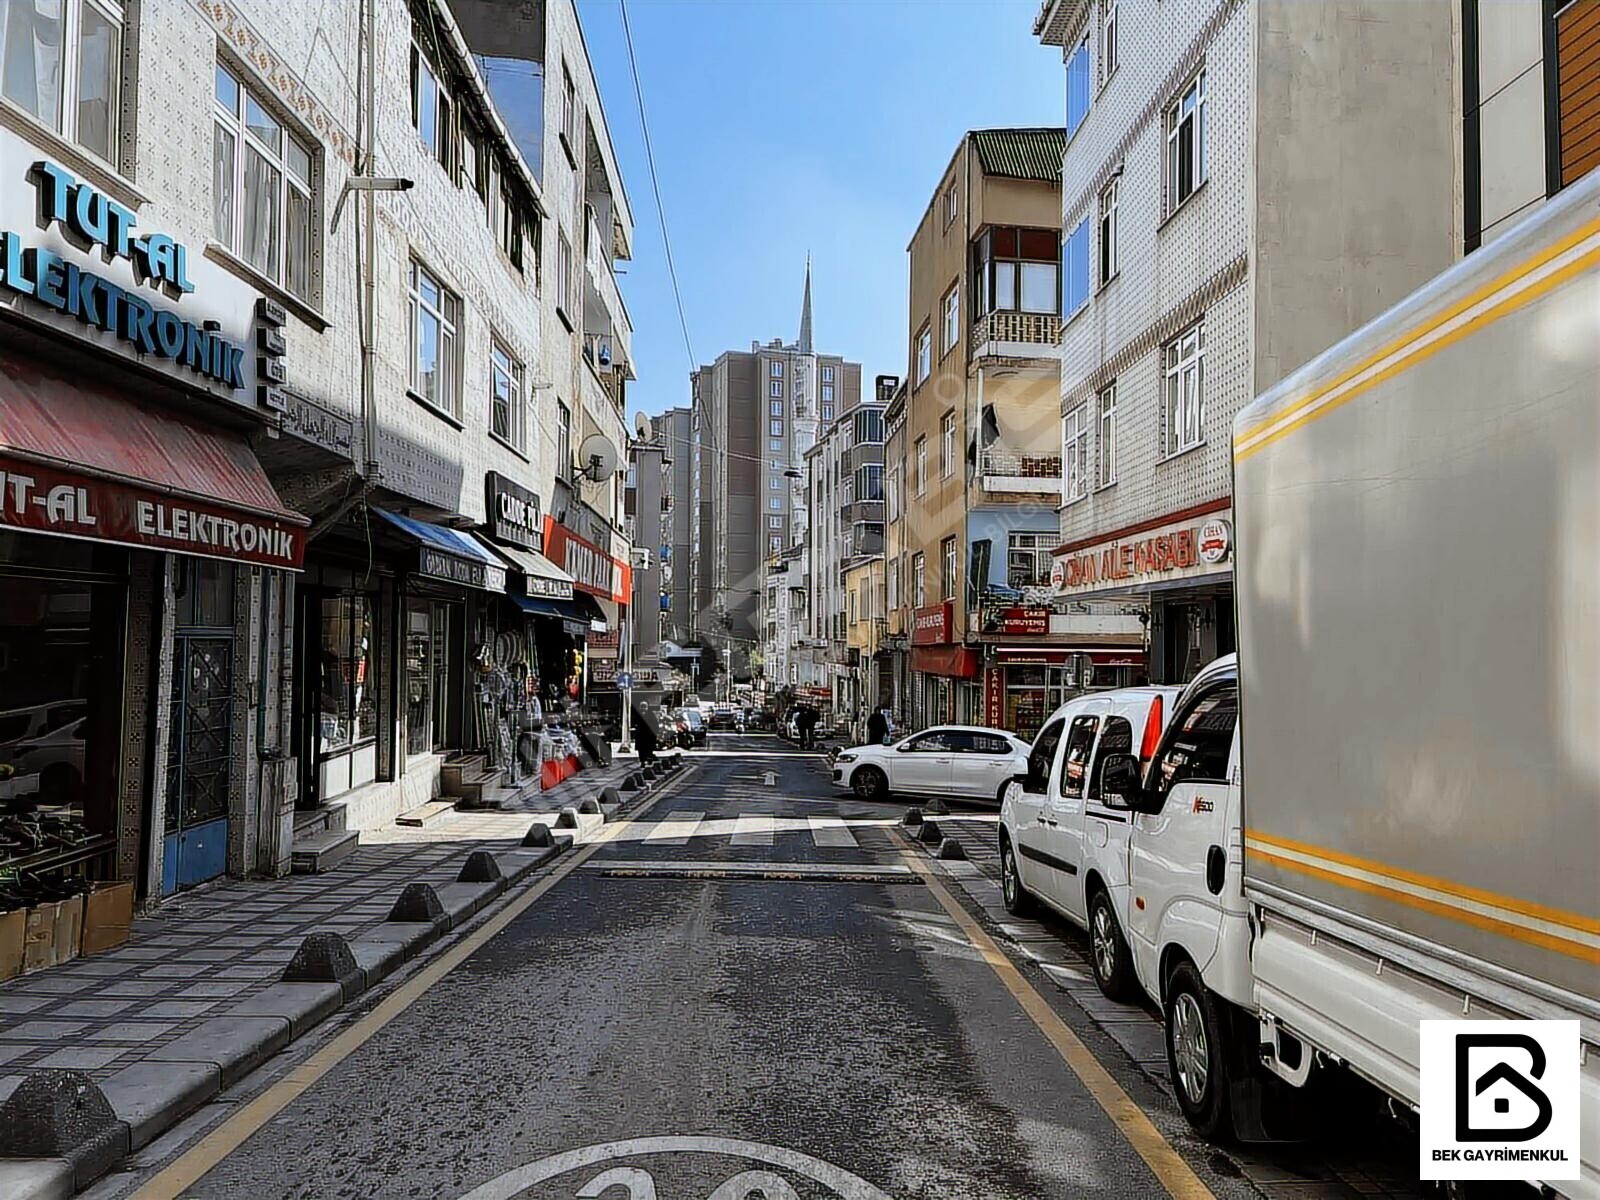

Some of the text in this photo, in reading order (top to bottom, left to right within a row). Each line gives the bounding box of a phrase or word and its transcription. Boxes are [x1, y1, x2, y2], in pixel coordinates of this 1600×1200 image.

[36, 161, 194, 294] TUT-AL
[0, 230, 246, 391] LEKTRONİK
[136, 498, 293, 561] ELEKTRONİK
